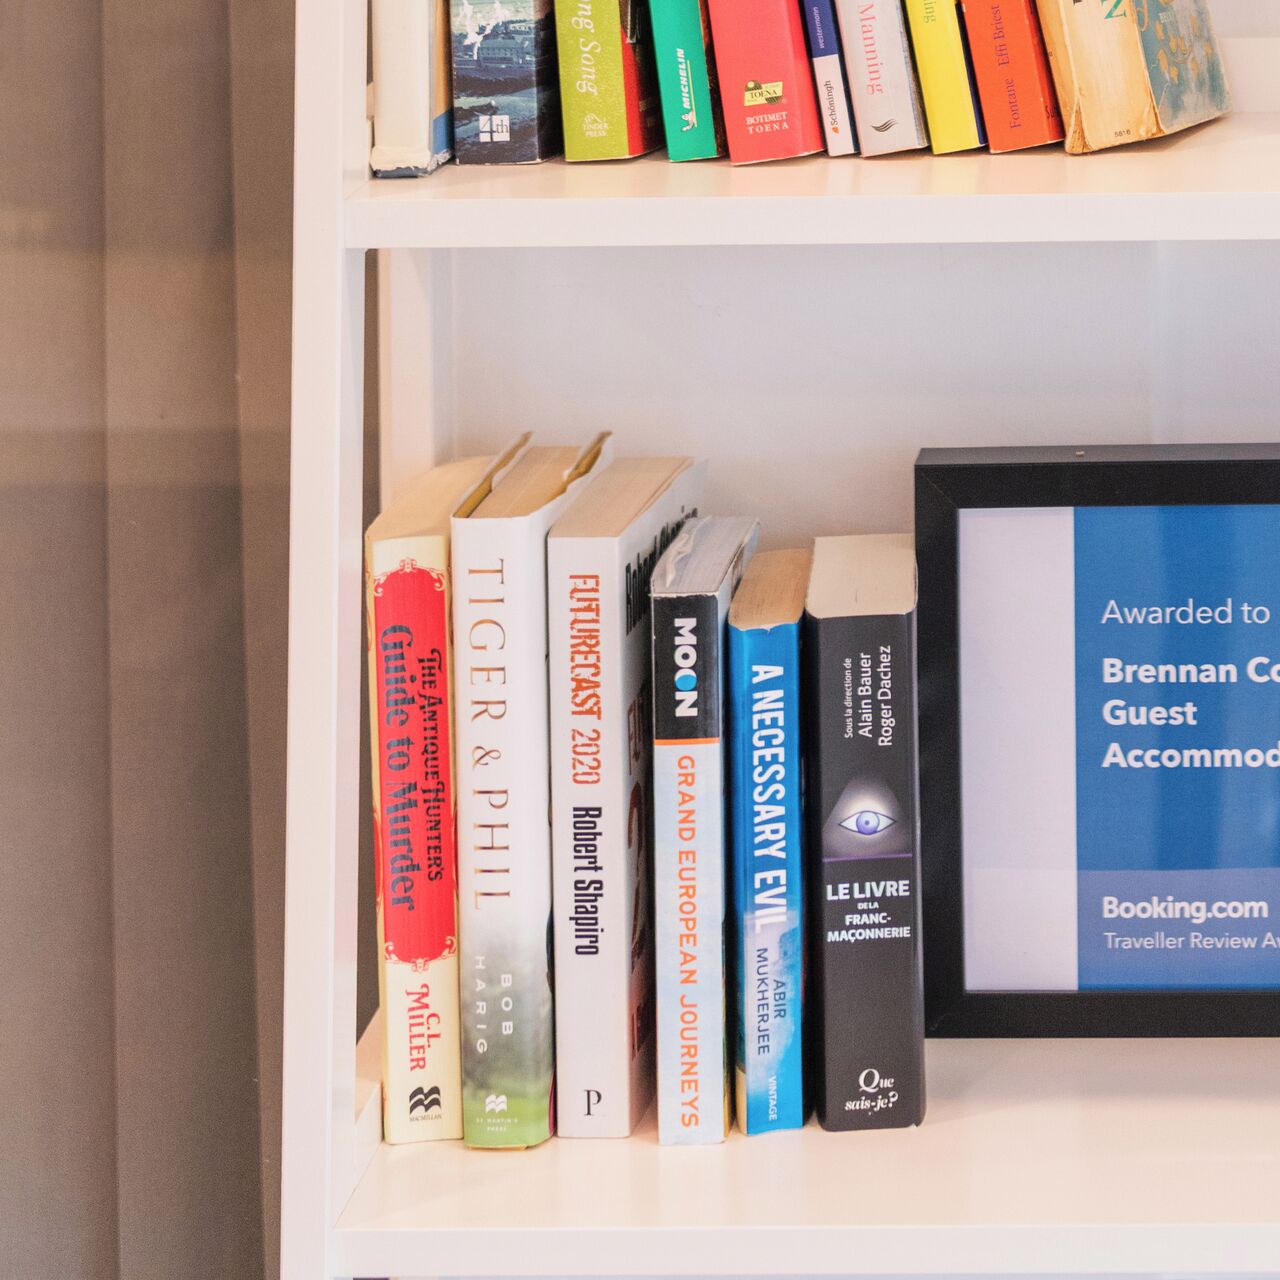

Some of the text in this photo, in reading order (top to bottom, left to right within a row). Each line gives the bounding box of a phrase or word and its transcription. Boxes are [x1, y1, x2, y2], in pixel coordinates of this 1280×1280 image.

[817, 6, 826, 49] westermann
[858, 3, 883, 96] Manning
[576, 38, 600, 96] Song
[676, 48, 691, 109] MICHELIN
[991, 4, 1021, 130] Fontane Effi Briest
[746, 112, 787, 125] BOTIMET
[748, 121, 789, 134] TOENA
[824, 80, 838, 126] Schöningh
[1100, 598, 1271, 625] Awarded to
[569, 574, 602, 785] FUTURECAST 2020
[674, 618, 698, 717] MOON
[857, 652, 872, 738] Alain Bauer
[876, 645, 895, 746] Roger Dachez
[1102, 657, 1238, 683] Brennan
[843, 657, 853, 739] Sous la direction de
[1102, 699, 1198, 725] Guest
[468, 558, 510, 910] TIGER & PHIL
[381, 625, 421, 911] Guide to Murder
[418, 648, 445, 881] THE ANTIQUE HUNTER'S
[752, 665, 787, 934] A NECESSARY EVIL
[569, 806, 604, 956] Robert Shapiro
[826, 880, 910, 900] LE LIVRE
[1102, 895, 1269, 924] Booking.com
[677, 756, 699, 1127] GRAND EUROPEAN JOURNEYS
[827, 927, 911, 943] MAÇONNERIE
[845, 913, 891, 926] FRANC-
[1104, 932, 1185, 949] Traveller
[1190, 932, 1257, 949] Review
[405, 983, 430, 1072] MILLER
[475, 956, 488, 1054] HARIG
[501, 974, 513, 1035] BOB
[756, 948, 770, 1055] MUKHERJEE
[773, 979, 786, 1019] ABIR
[584, 1089, 602, 1116] P
[768, 1075, 777, 1121] VINTAGE
[845, 1091, 898, 1111] sais-je?
[859, 1068, 894, 1093] Que
